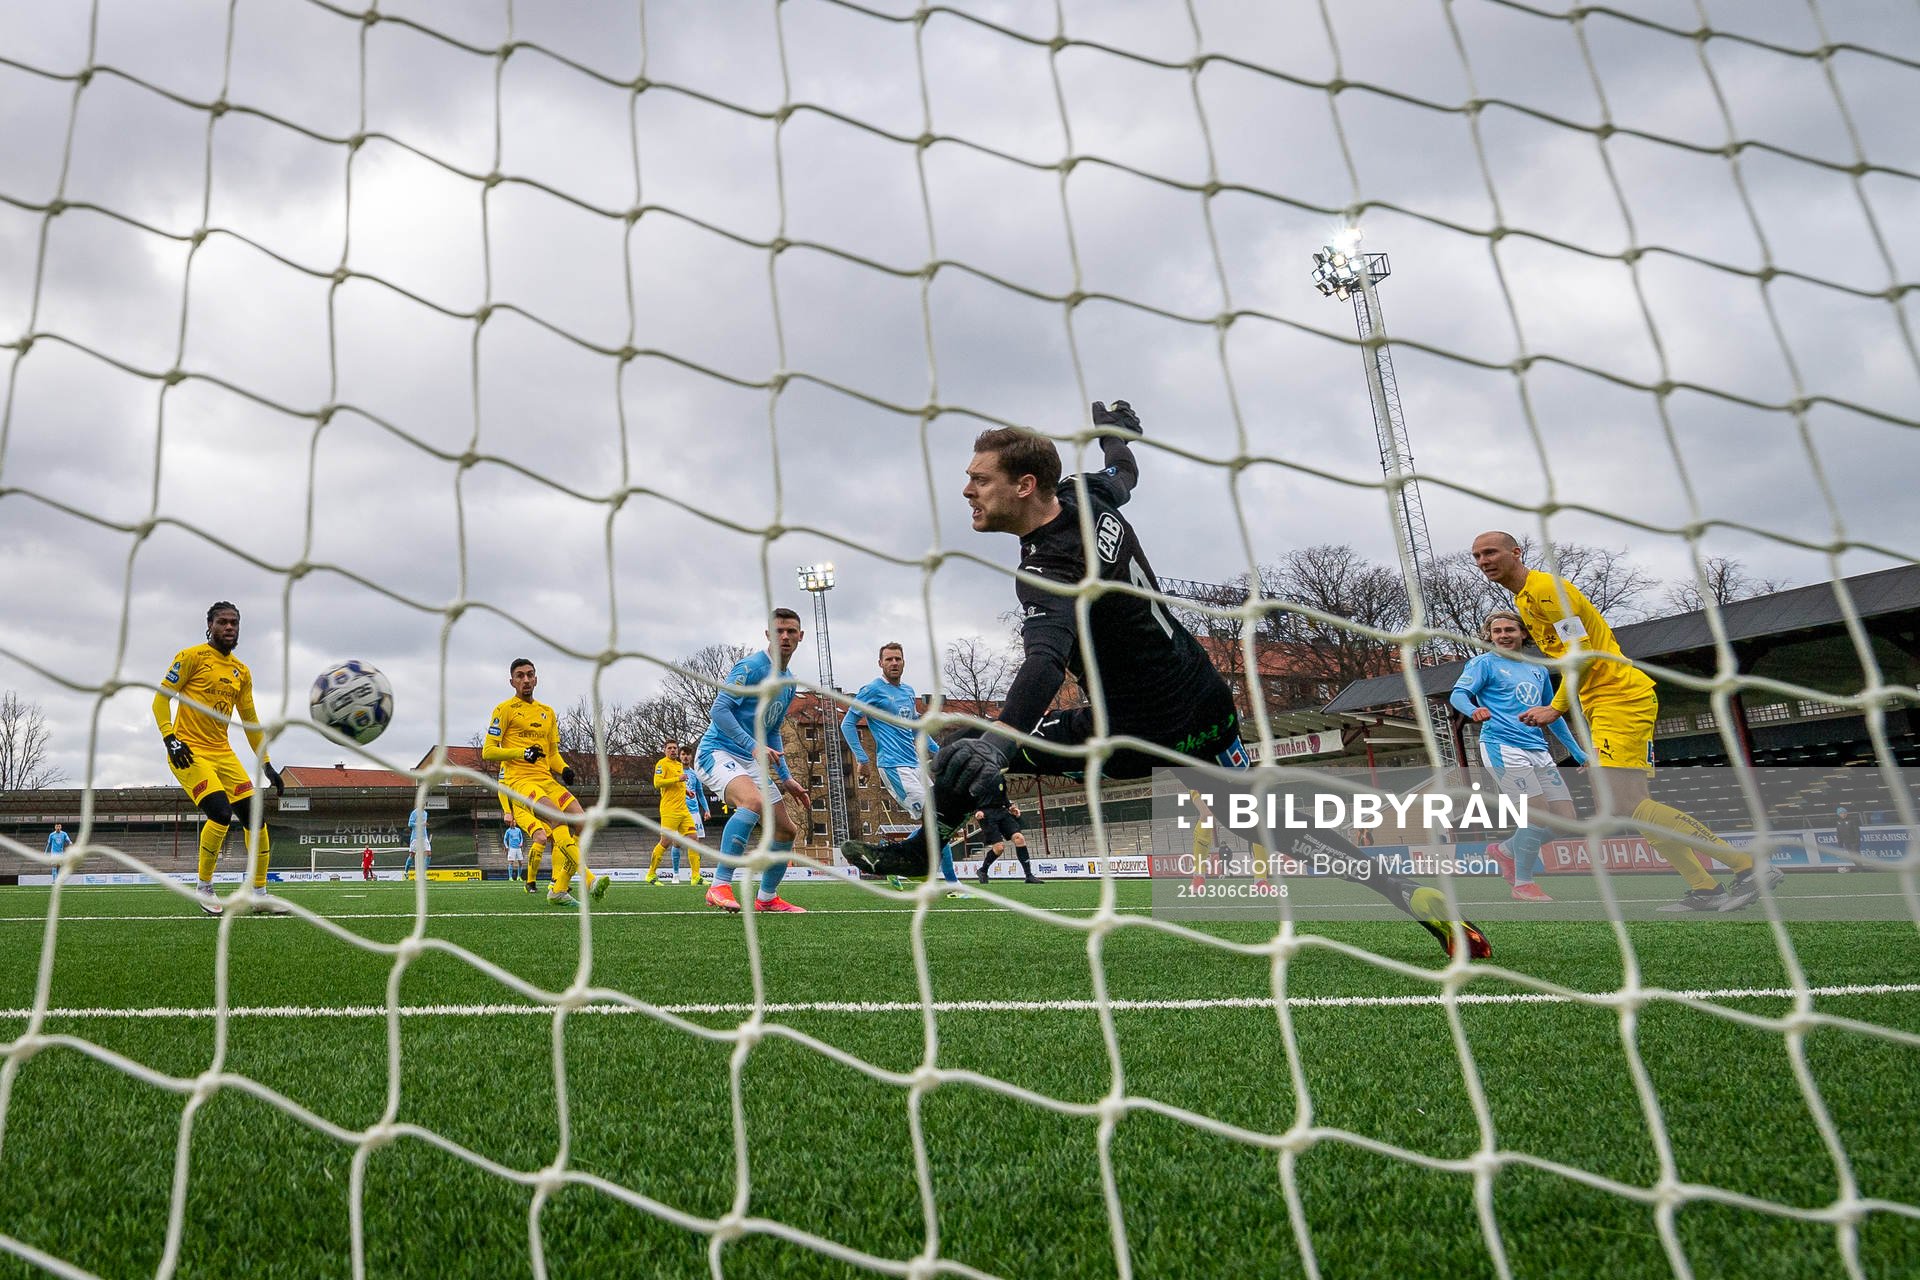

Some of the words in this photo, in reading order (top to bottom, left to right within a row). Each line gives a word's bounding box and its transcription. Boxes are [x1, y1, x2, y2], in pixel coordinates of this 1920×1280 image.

[1097, 515, 1121, 561] EAB
[335, 820, 383, 834] EXPECT
[299, 833, 348, 845] BETTER
[1556, 842, 1669, 866] BAUHA
[1879, 849, 1903, 858] ALLA
